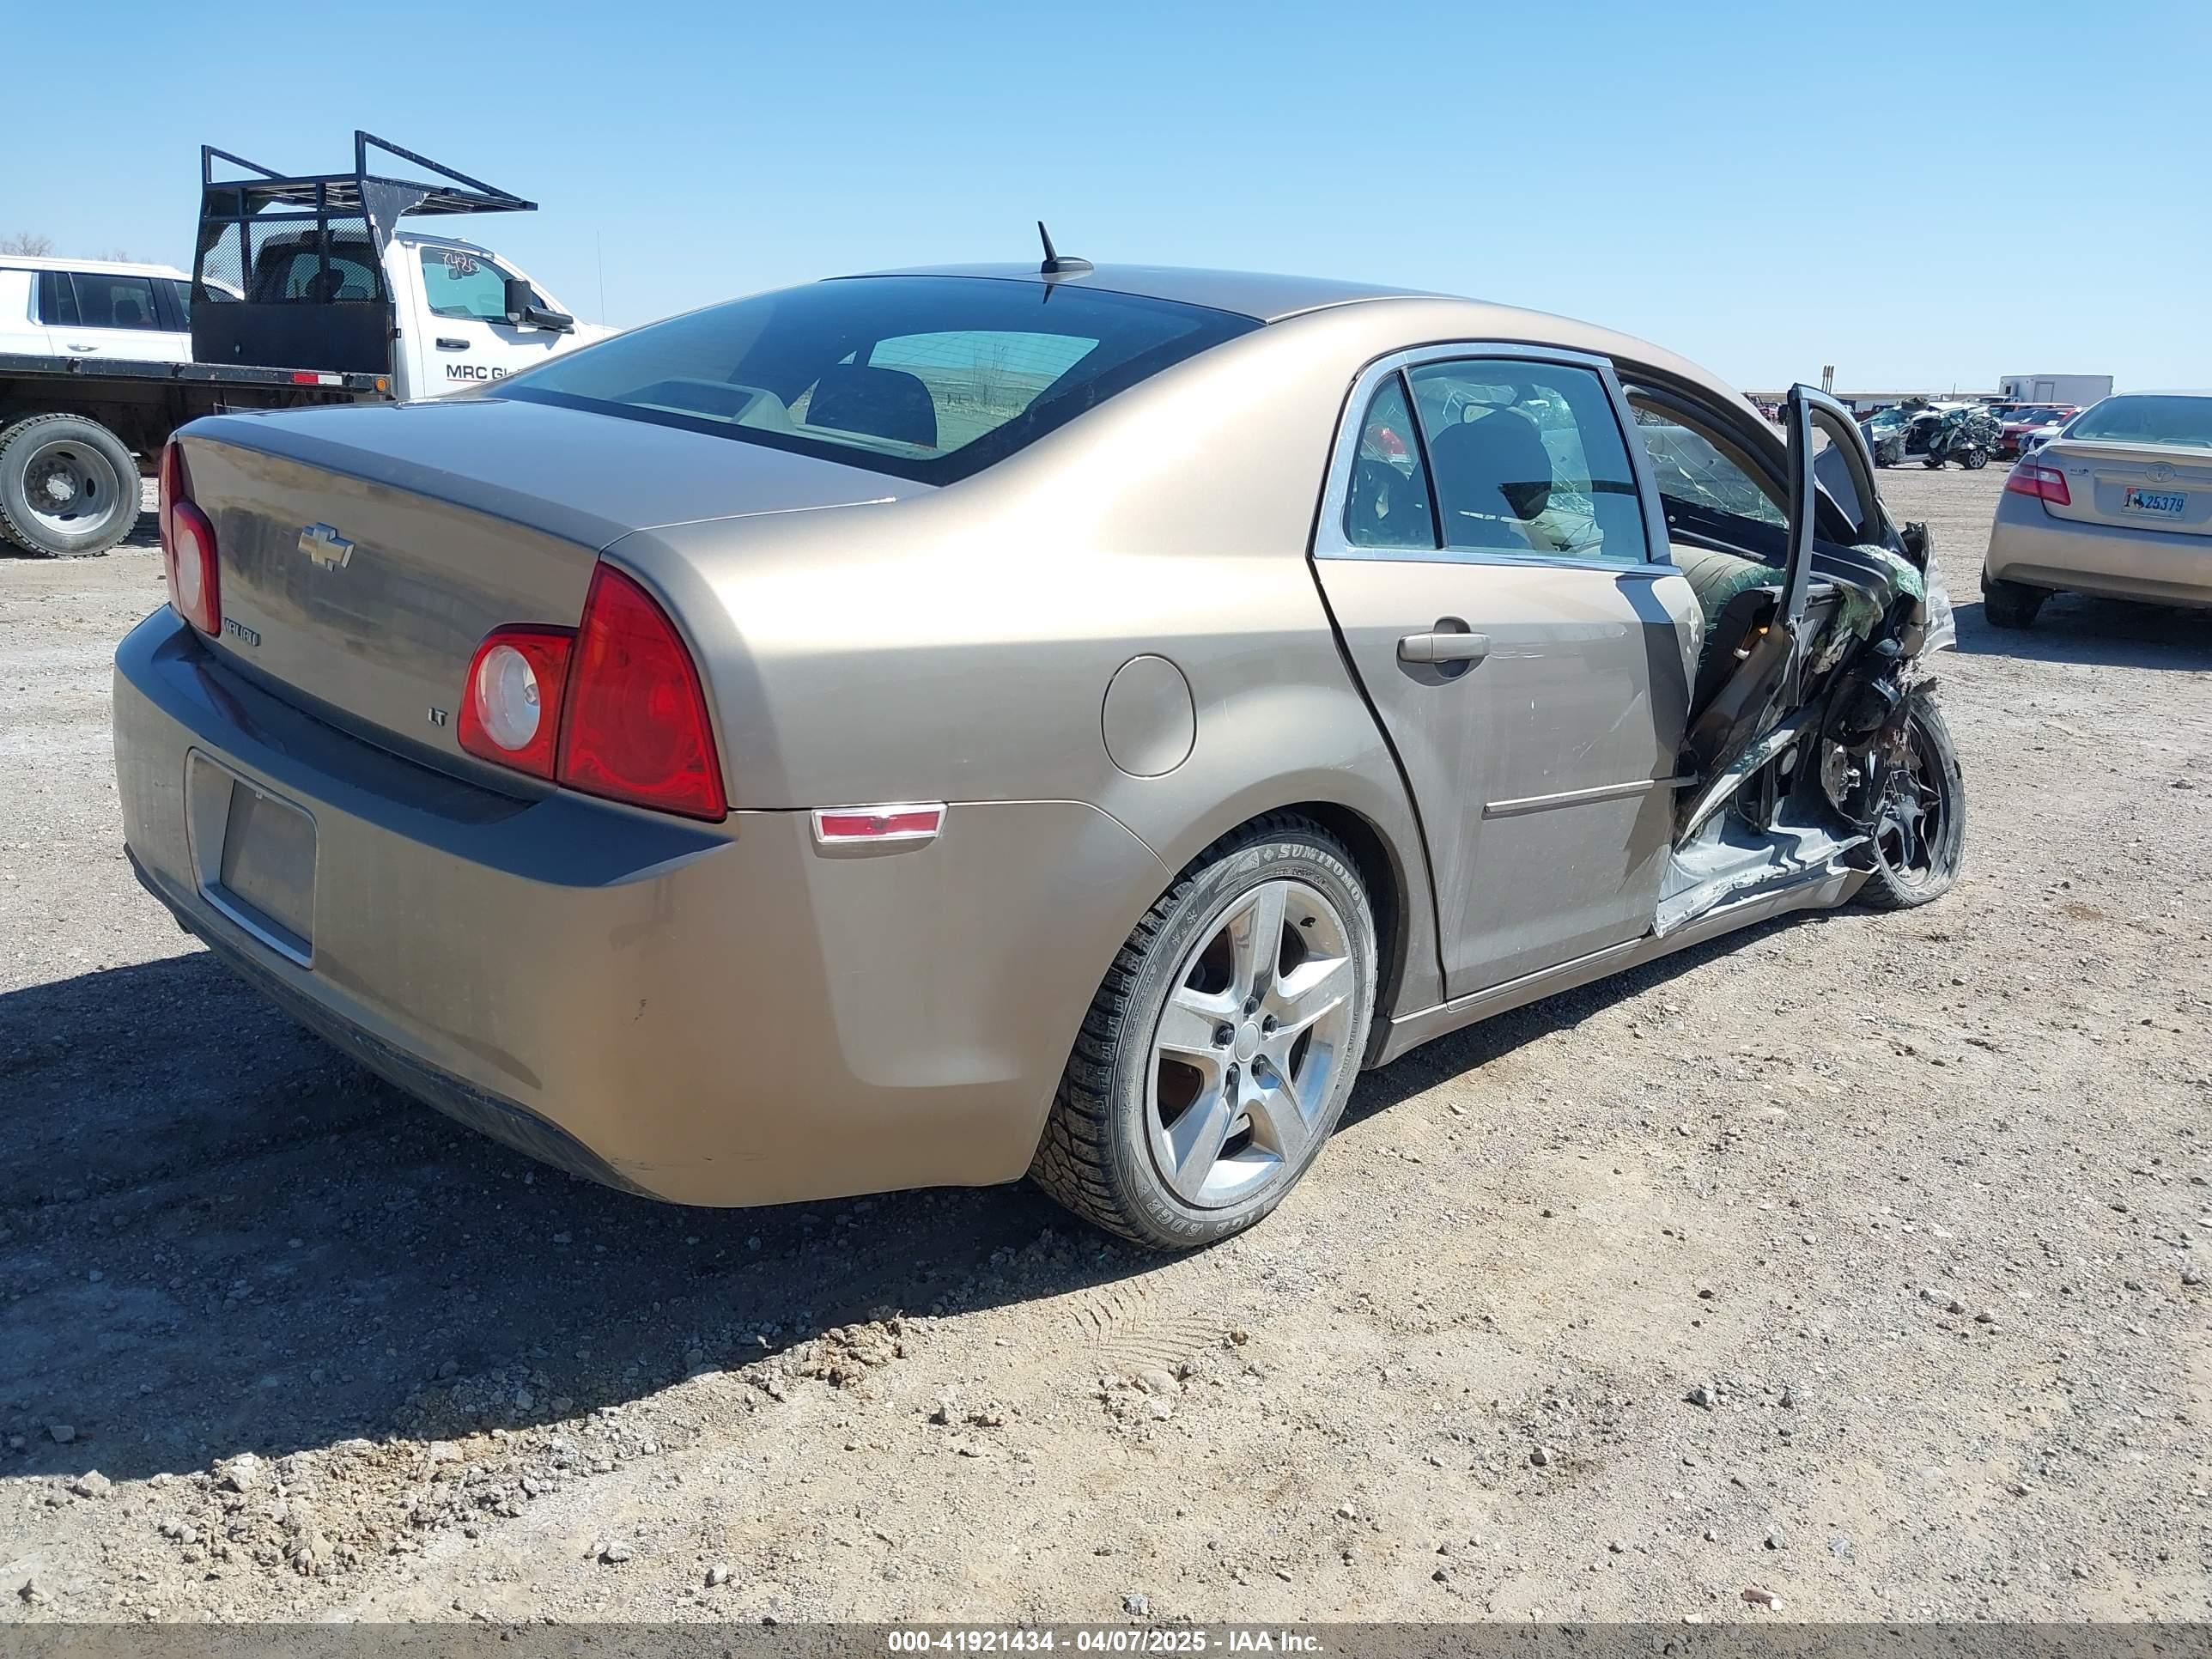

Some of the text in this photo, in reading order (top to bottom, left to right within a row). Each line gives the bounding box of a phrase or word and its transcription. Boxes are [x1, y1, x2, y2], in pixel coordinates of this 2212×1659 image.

[446, 364, 488, 380] MRC
[2146, 495, 2185, 512] 25379
[428, 707, 448, 727] LT
[1278, 844, 1361, 901] SUMITOMO
[1146, 1198, 1204, 1237] EDGE
